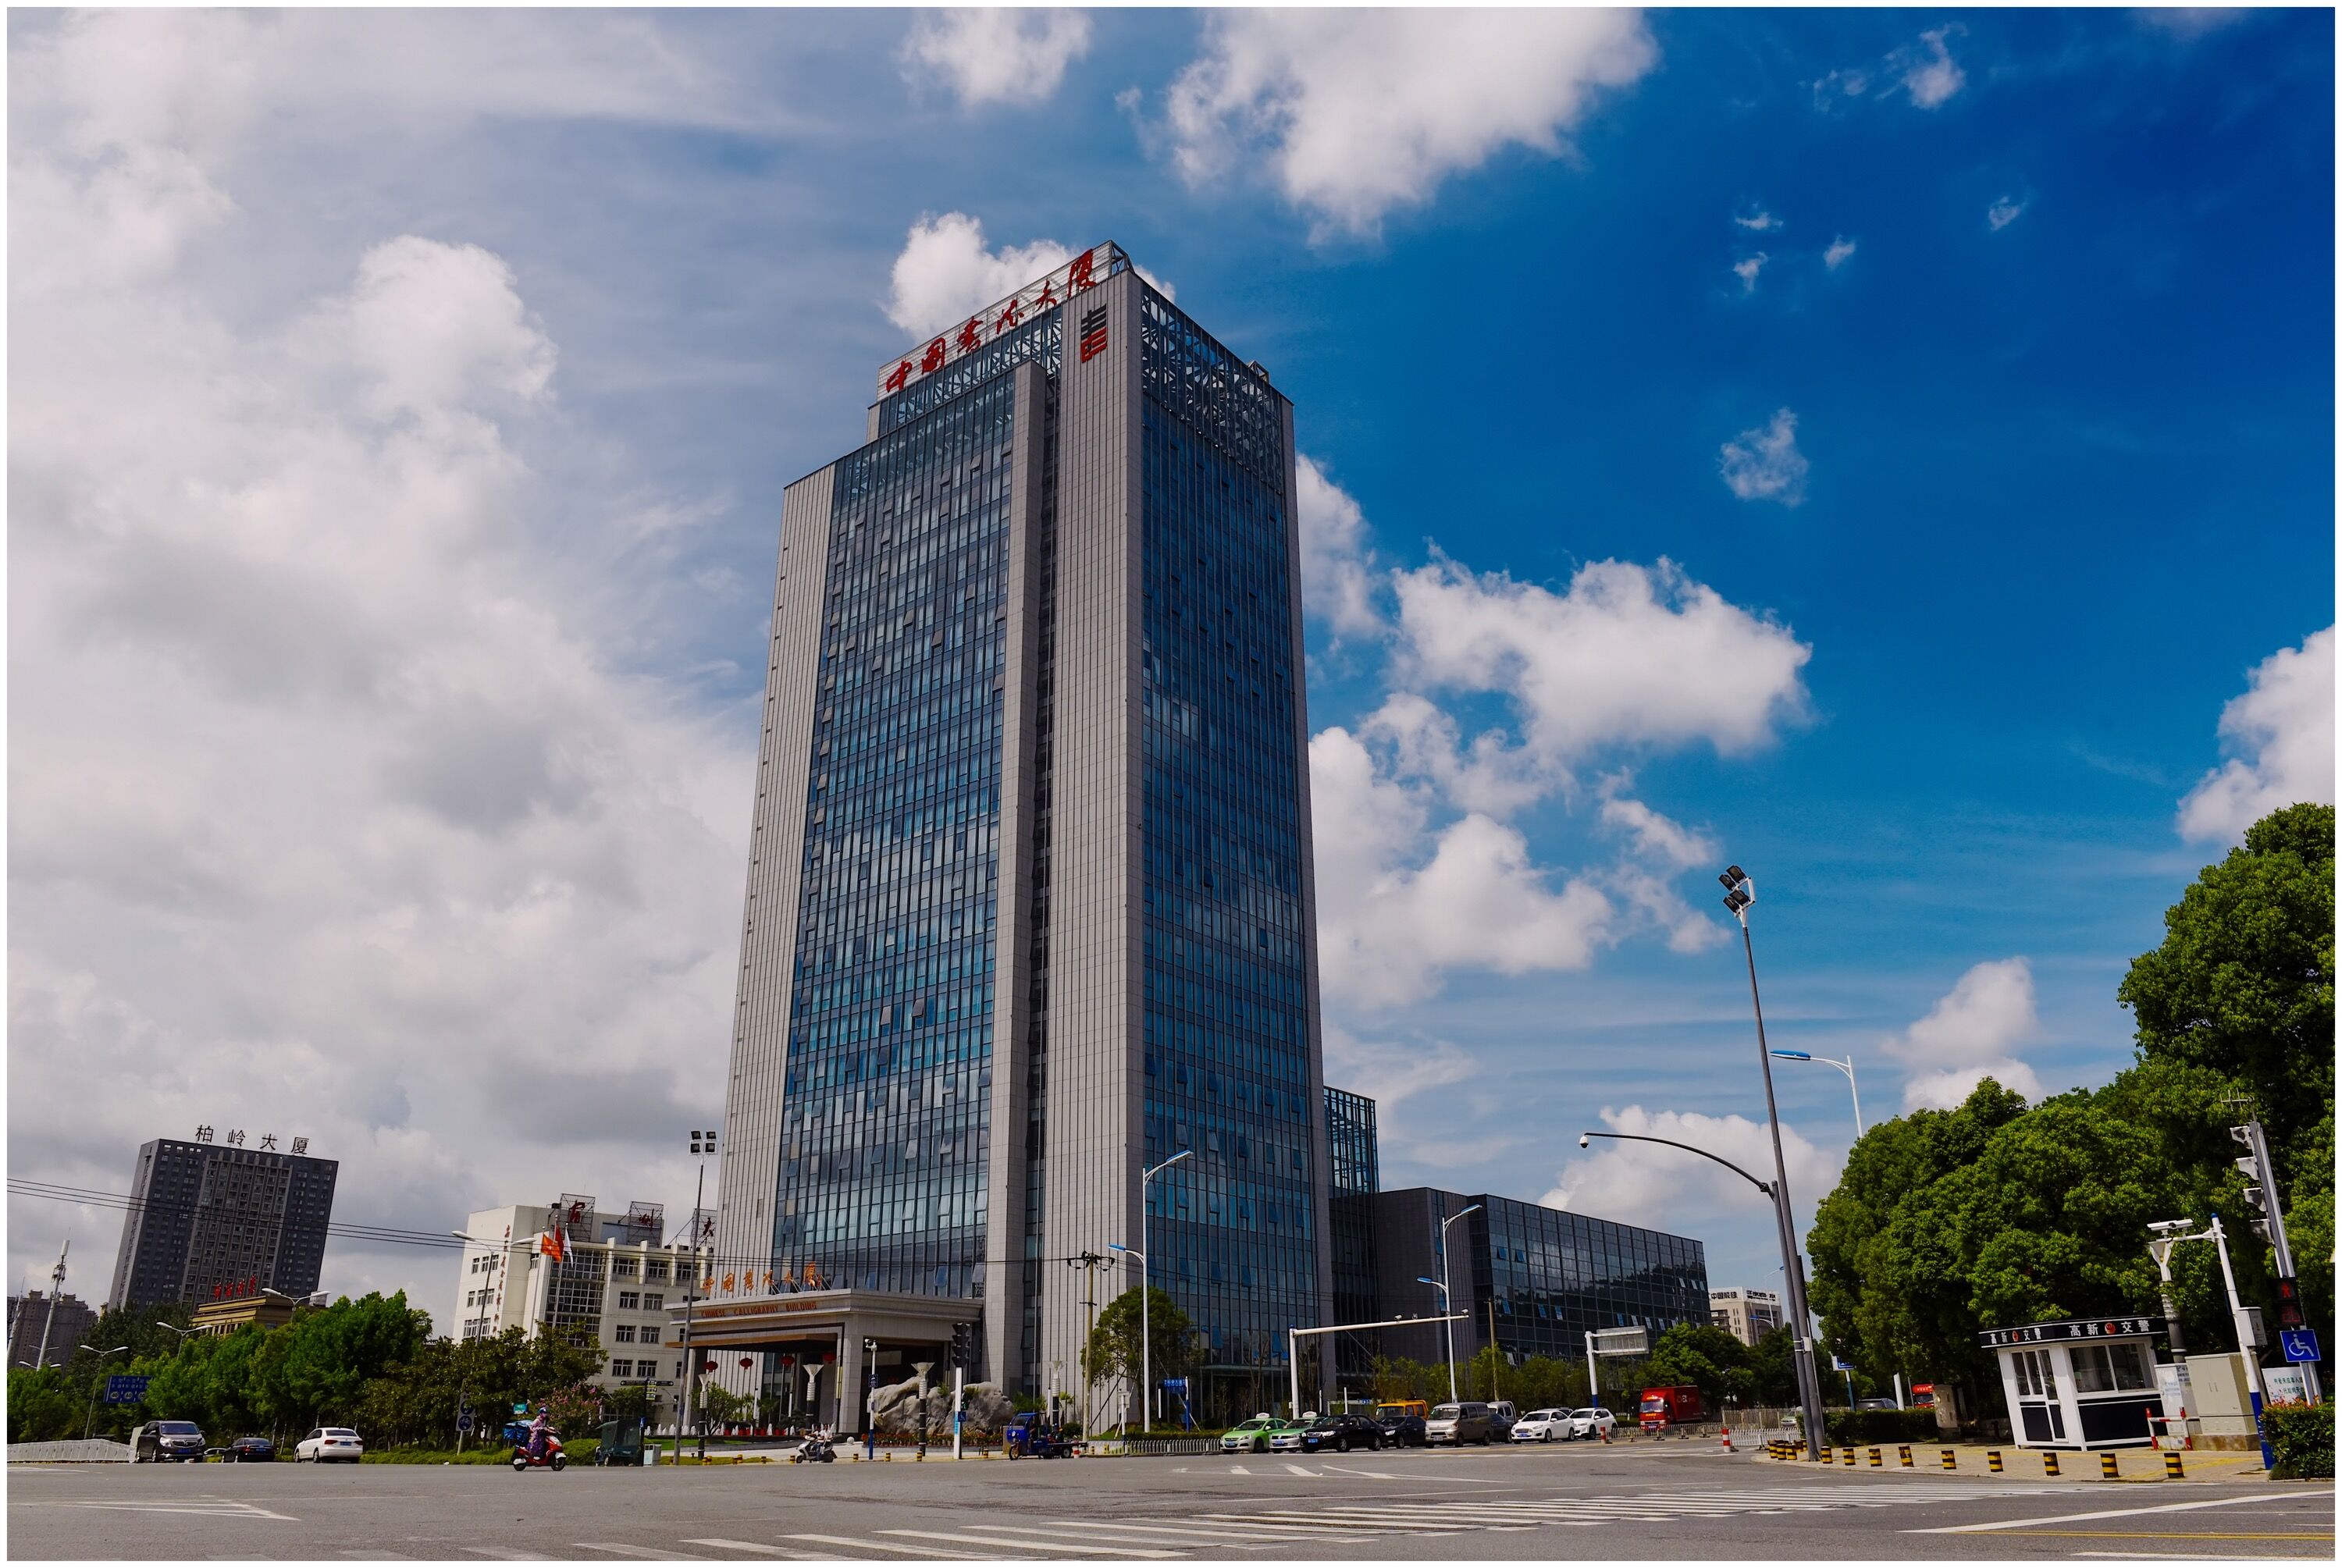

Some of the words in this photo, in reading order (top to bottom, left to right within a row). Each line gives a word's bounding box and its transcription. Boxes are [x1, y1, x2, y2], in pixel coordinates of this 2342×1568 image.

[195, 1124, 309, 1155] 柏岭大厦
[701, 1309, 726, 1318] CHINESE
[734, 1303, 779, 1316] CALLIGRAPHY
[785, 1301, 817, 1312] BUILDING
